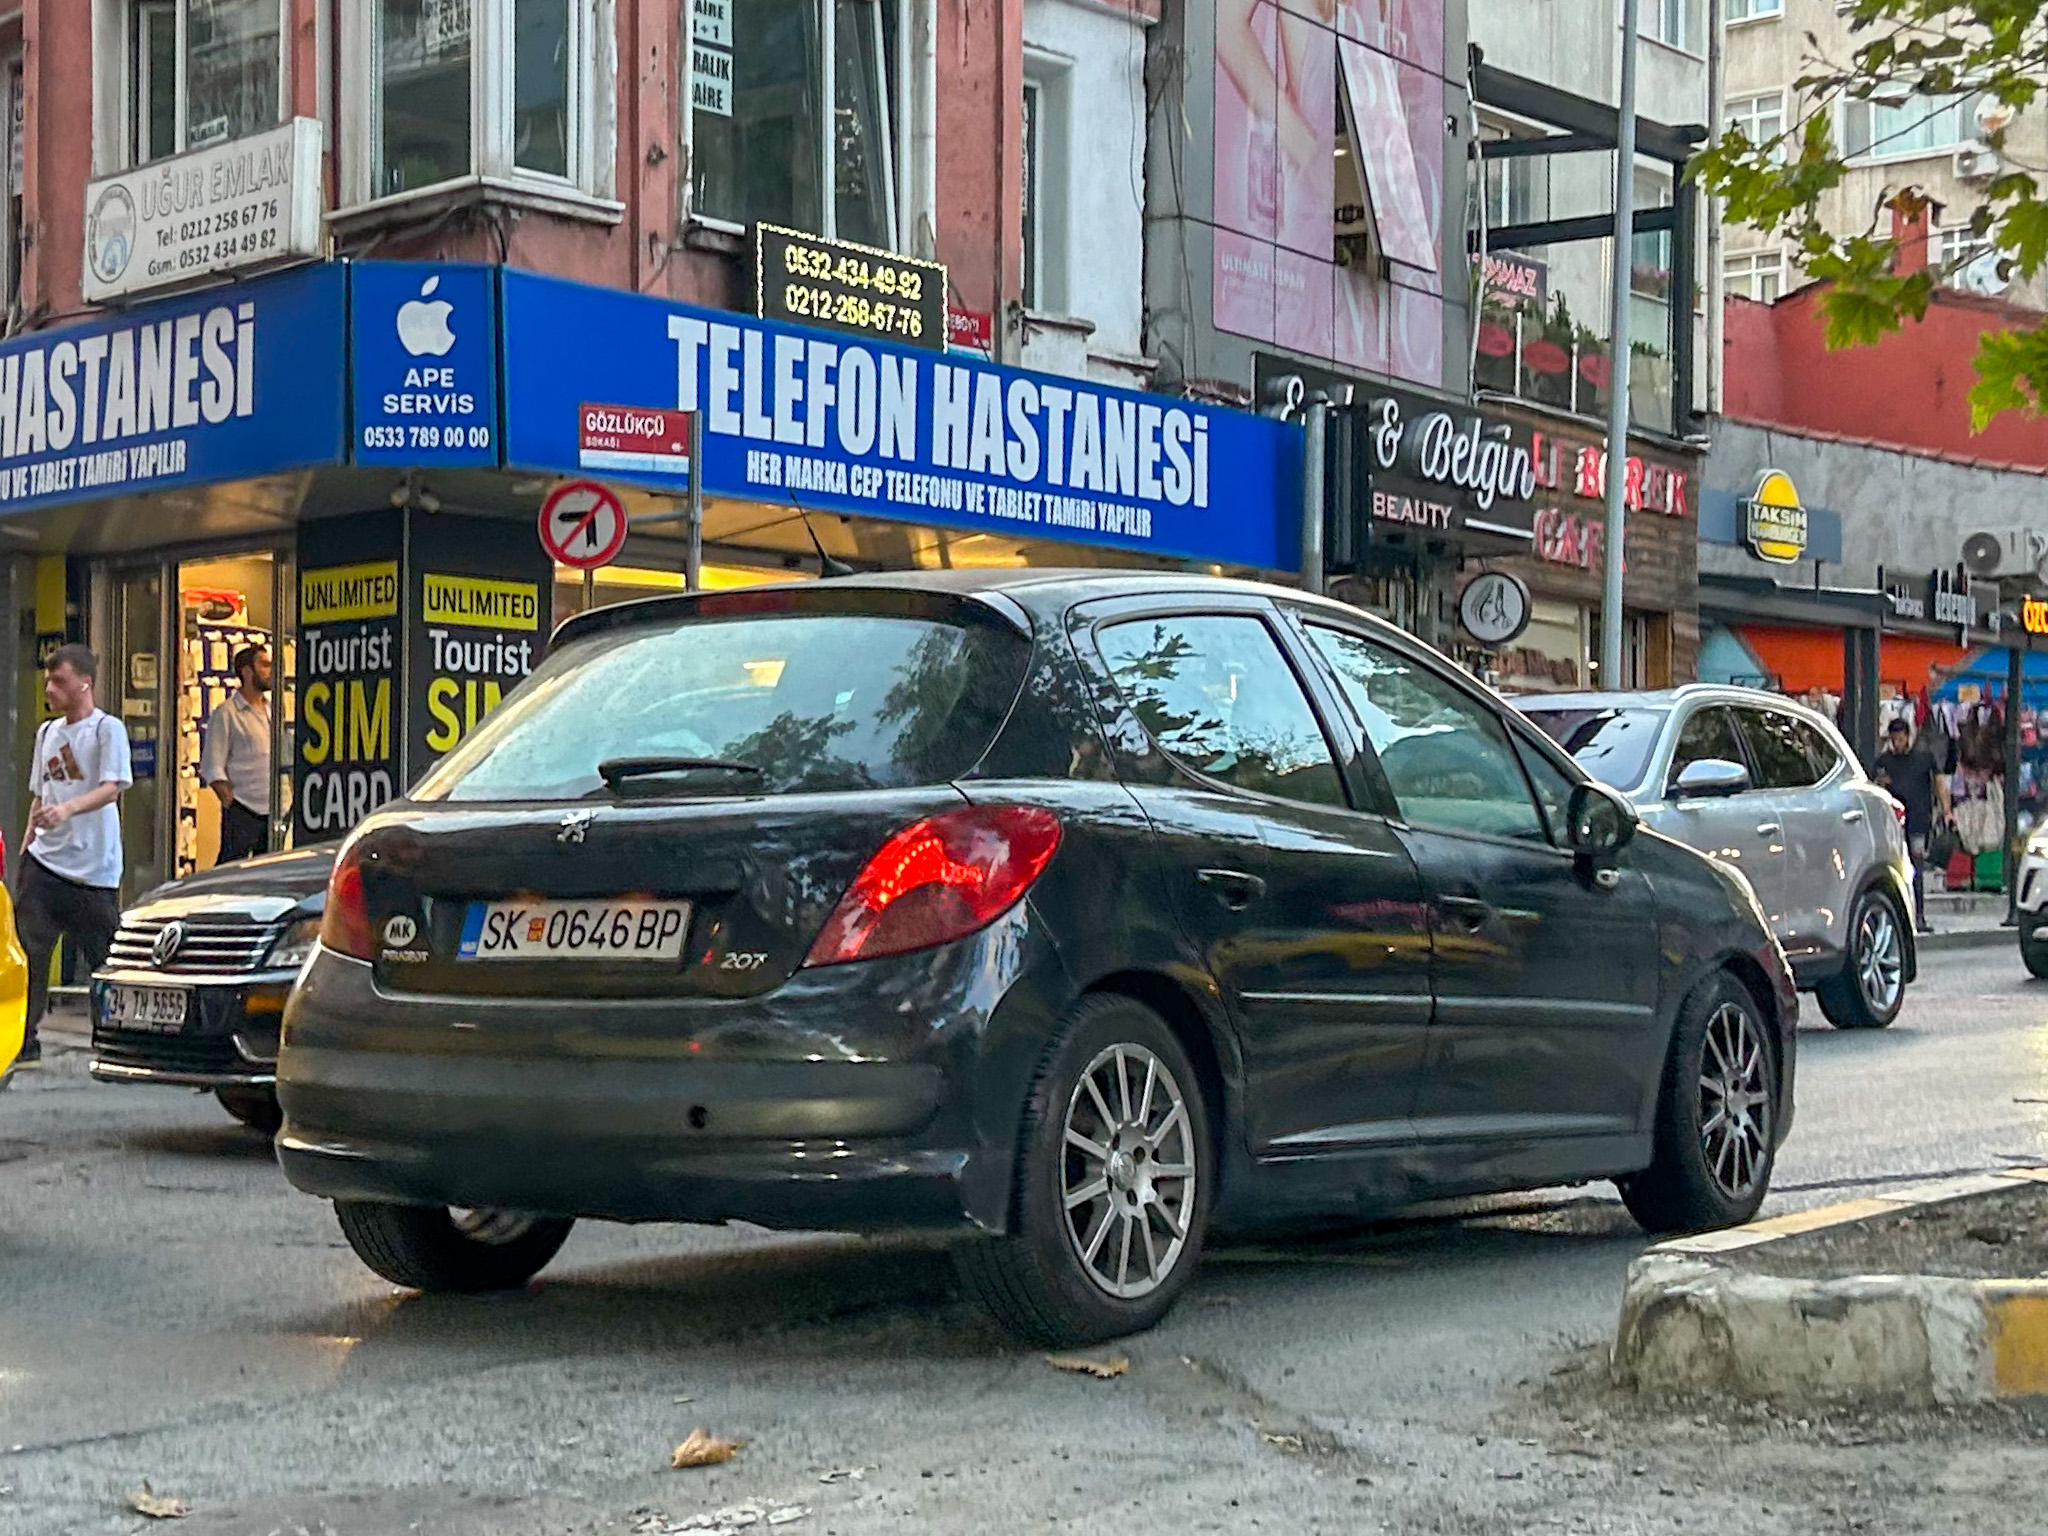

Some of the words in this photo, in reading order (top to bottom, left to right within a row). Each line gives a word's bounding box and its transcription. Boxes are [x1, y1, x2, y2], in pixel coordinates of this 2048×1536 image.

[141, 165, 205, 222] UĞUR
[210, 142, 289, 205] EMLAK
[180, 218, 211, 242] 0212
[214, 210, 238, 232] 258
[242, 204, 258, 227] 67
[262, 199, 278, 221] 76
[179, 247, 210, 269] 0532
[213, 239, 237, 260] 434
[241, 233, 257, 254] 49
[260, 227, 277, 249] 82
[0, 302, 254, 458] HASTANESİ
[404, 367, 455, 388] APE
[383, 392, 474, 414] SERVİS
[668, 314, 918, 462] TELEFON
[932, 363, 1209, 509] HASTANESİ
[364, 426, 406, 447] 0533
[408, 426, 440, 448] 789
[443, 426, 465, 448] 00
[468, 426, 489, 448] 00
[585, 410, 666, 440] GÖZLÜKÇÜ
[12, 466, 29, 498] VE
[30, 457, 77, 495] TABLET
[78, 449, 128, 488] TAMİRİ
[129, 440, 187, 480] YAPILIR
[1377, 398, 1404, 469] &
[1421, 412, 1537, 511] Belgin
[746, 450, 783, 487] HER
[784, 454, 849, 496] MARKA
[850, 464, 884, 500] CEP
[885, 468, 963, 511] TELEFONU
[965, 481, 985, 514] VE
[987, 485, 1042, 522] TABLET
[1044, 494, 1096, 531] TAMİRİ
[1098, 501, 1151, 538] YAPILIR
[1574, 436, 1688, 519] BREK
[1372, 491, 1453, 530] BEAUTY
[305, 575, 395, 611] UNLIMITED
[428, 585, 535, 619] UNLIMITED
[305, 625, 393, 675] Tourist
[429, 629, 532, 676] Tourist
[302, 677, 391, 765] SIM
[389, 923, 411, 938] MK
[484, 910, 527, 950] SK
